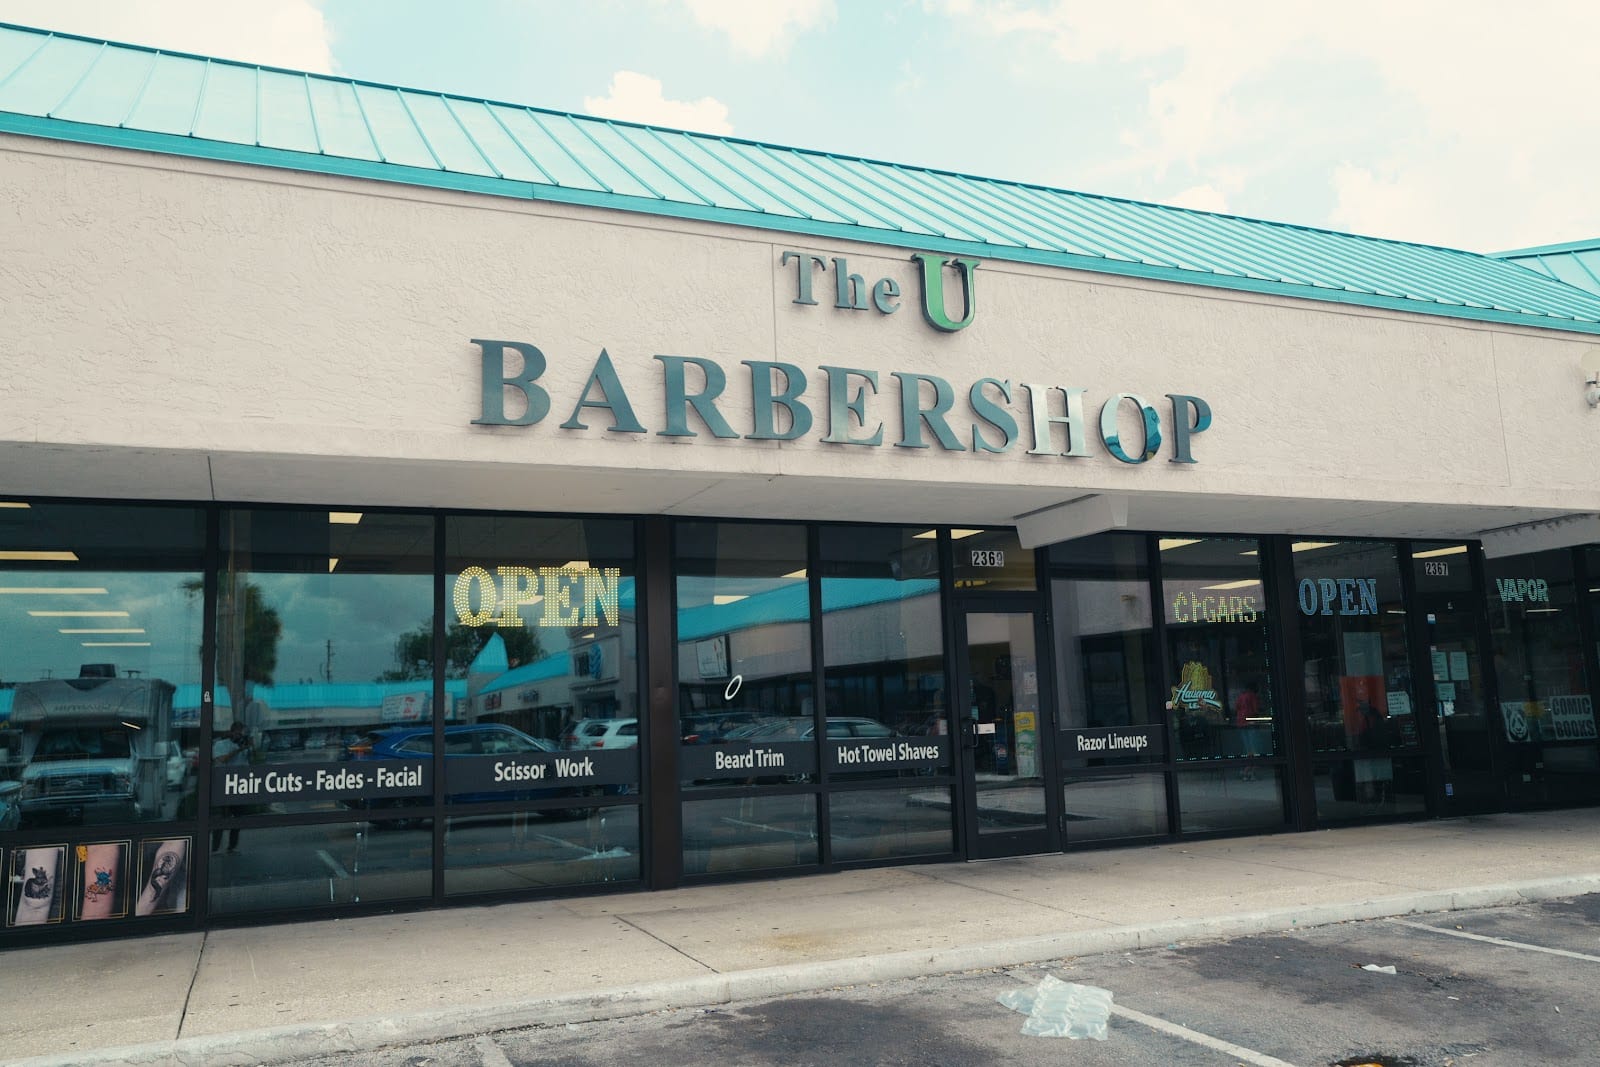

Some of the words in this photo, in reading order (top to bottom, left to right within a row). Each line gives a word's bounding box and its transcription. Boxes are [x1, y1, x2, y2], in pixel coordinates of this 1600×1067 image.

[782, 250, 900, 315] The
[911, 253, 980, 334] U
[470, 338, 1213, 465] BARBERSHOP
[1425, 562, 1448, 576] 2367
[453, 566, 621, 628] OPEN
[1298, 578, 1378, 616] OPEN
[1496, 578, 1550, 602] VAPOR
[1173, 592, 1258, 624] CIGARS
[1552, 696, 1592, 716] COMIC
[1077, 735, 1107, 751] Razor
[1108, 733, 1148, 751] Lineups
[1556, 721, 1596, 740] BOOKS
[715, 751, 753, 770] Beard
[755, 749, 785, 768] Trim
[837, 745, 860, 764] Hot
[862, 744, 897, 763] Towel
[899, 742, 939, 761] Shaves
[225, 773, 262, 795] Hair
[265, 771, 302, 792] Cuts
[316, 769, 364, 790] Fades
[377, 765, 423, 787] Facial
[494, 762, 546, 783] Scissor
[555, 756, 594, 779] Work
